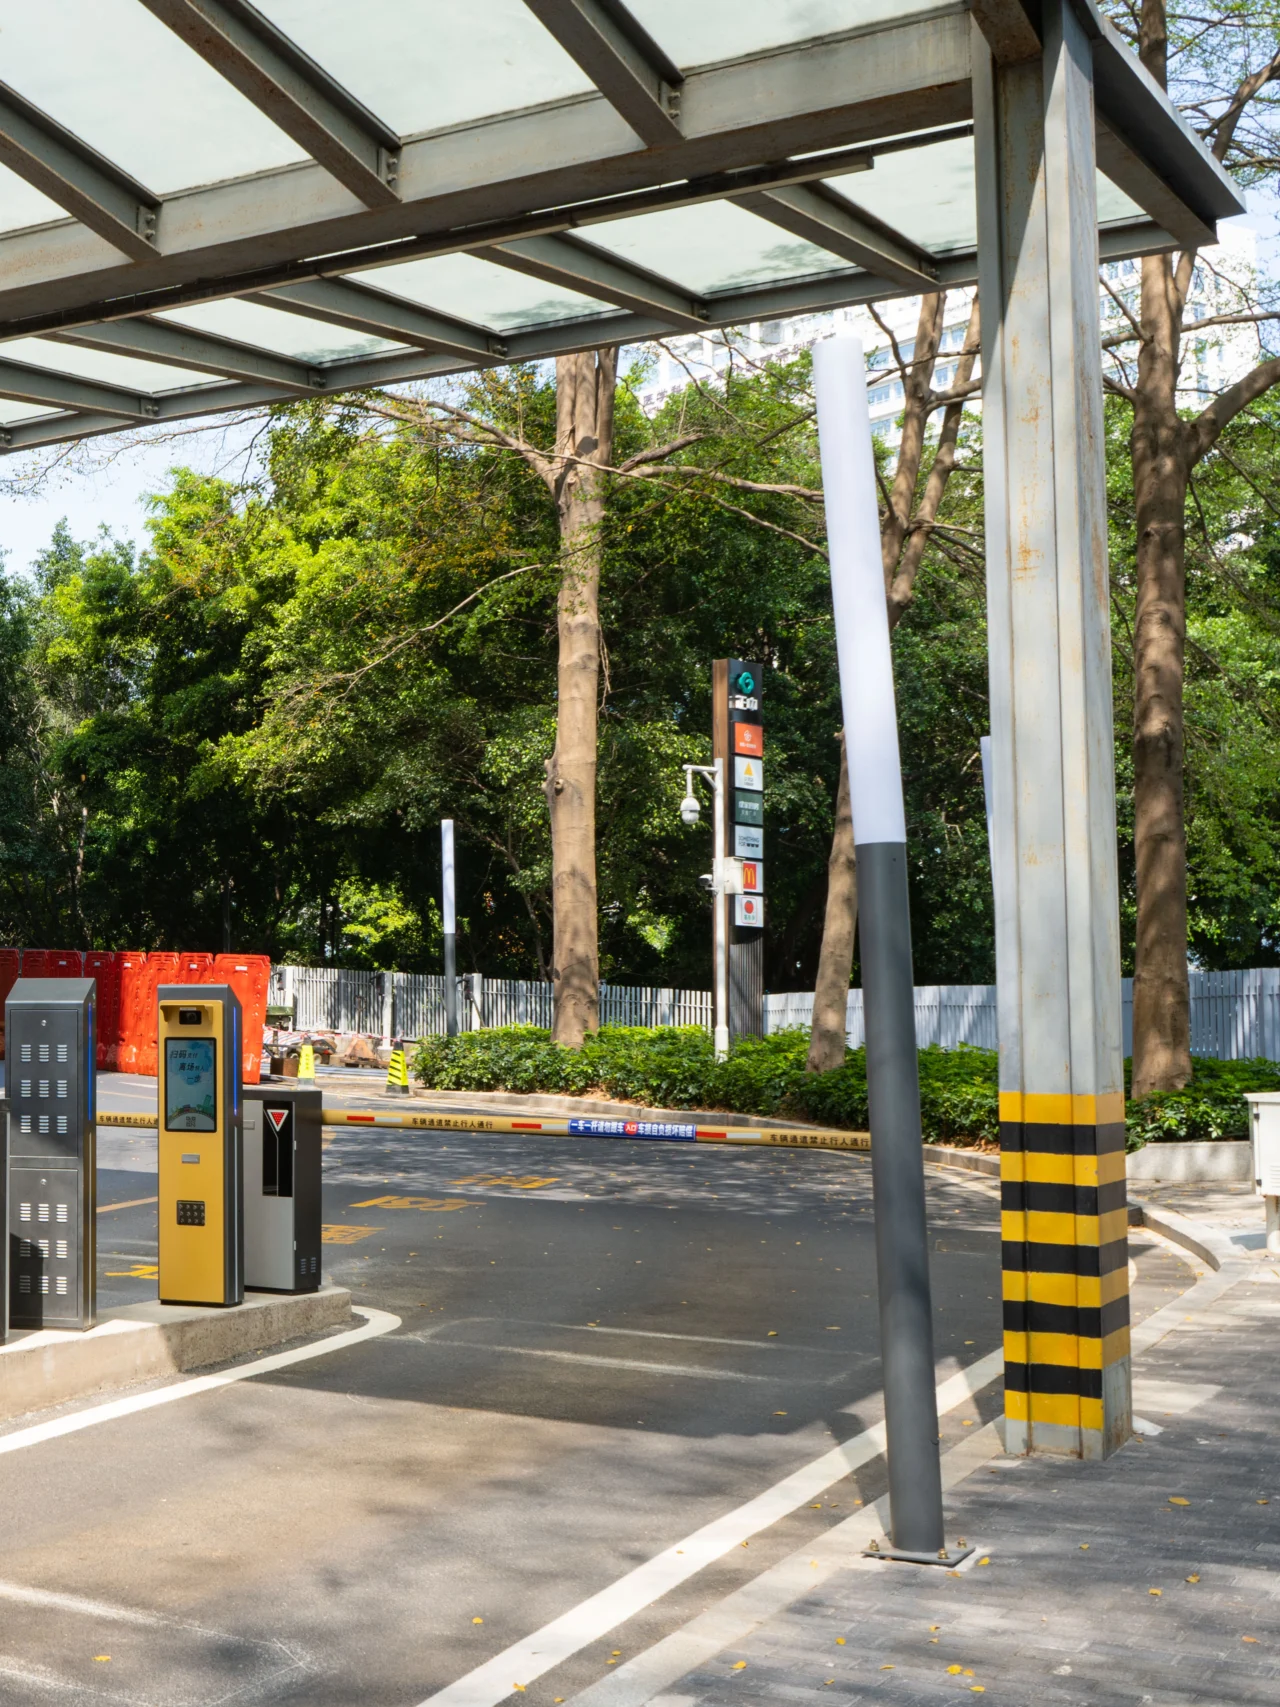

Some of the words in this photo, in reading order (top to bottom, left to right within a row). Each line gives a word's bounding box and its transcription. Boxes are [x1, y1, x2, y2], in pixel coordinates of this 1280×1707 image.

[412, 1117, 493, 1129] 车辆通道禁止行人通行
[770, 1134, 869, 1147] 车辆通道禁止行人通行
